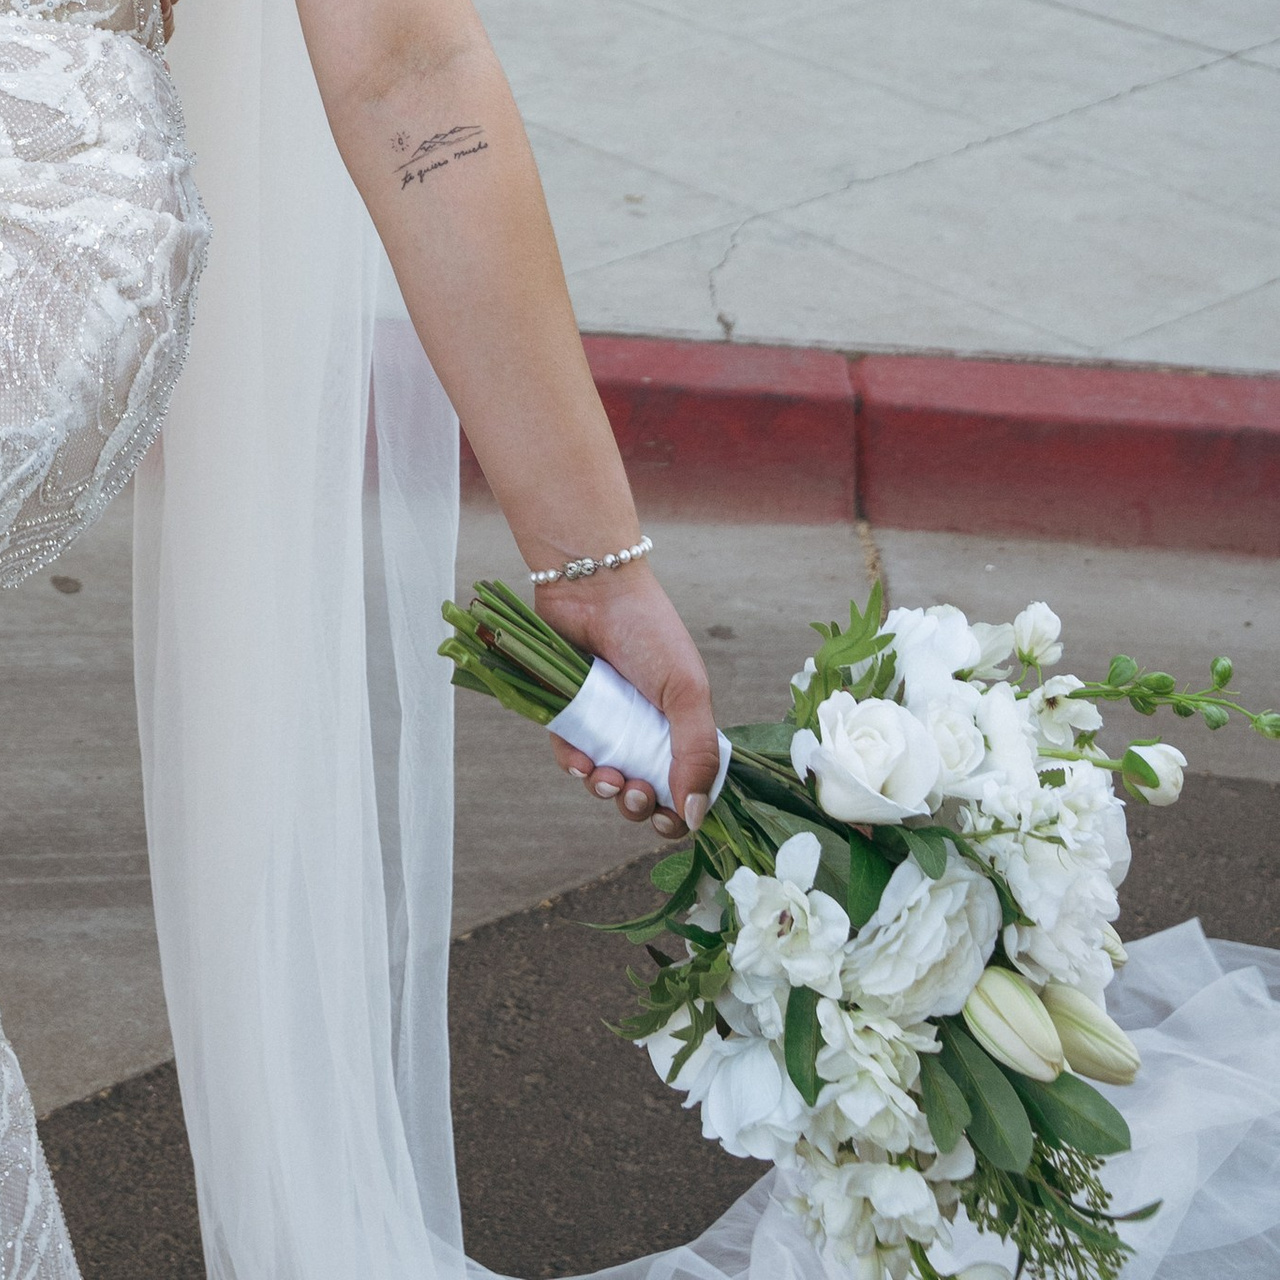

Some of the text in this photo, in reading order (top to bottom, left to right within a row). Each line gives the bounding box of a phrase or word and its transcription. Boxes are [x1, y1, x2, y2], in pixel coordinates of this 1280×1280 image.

[401, 141, 488, 190] te quiero mucho
